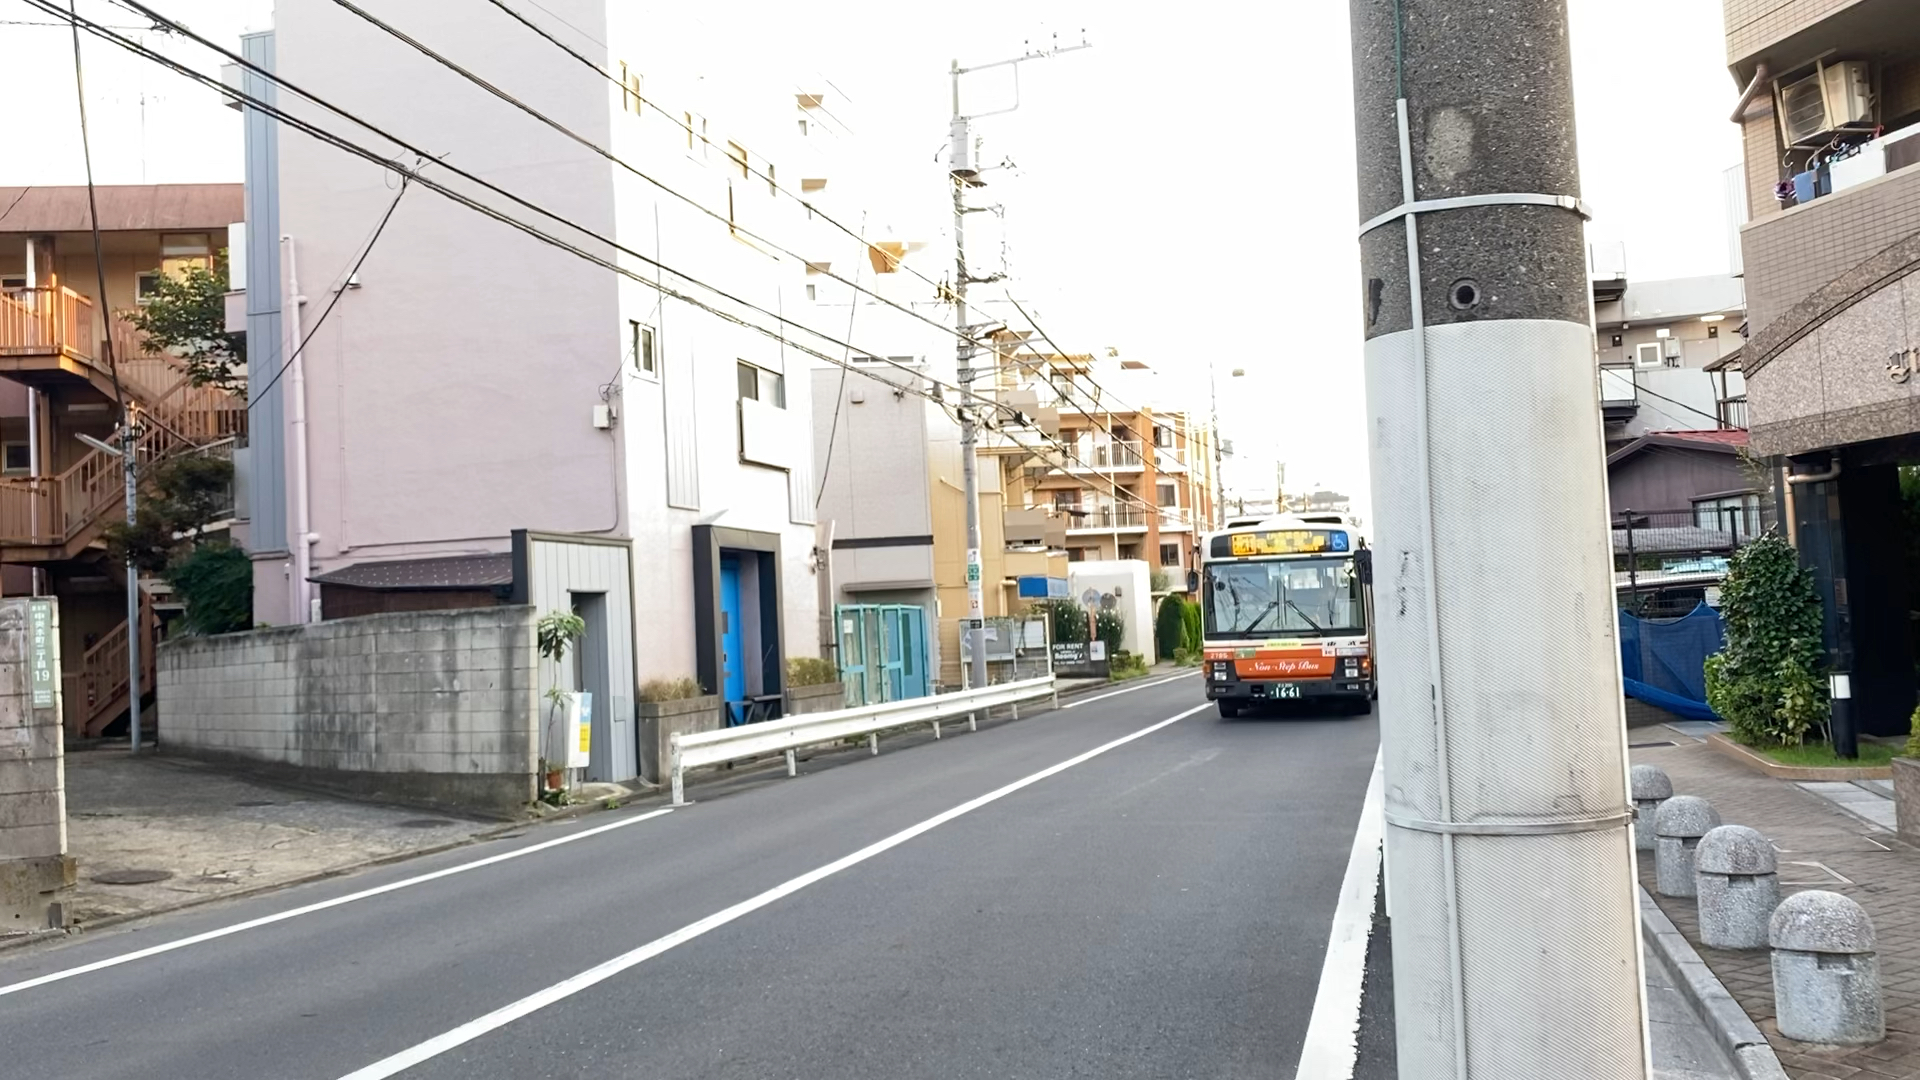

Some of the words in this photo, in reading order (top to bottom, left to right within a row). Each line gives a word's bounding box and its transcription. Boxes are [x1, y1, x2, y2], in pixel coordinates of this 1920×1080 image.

[1052, 643, 1066, 651] FOR
[1066, 641, 1084, 650] RENT
[1297, 660, 1320, 671] Bus
[34, 669, 50, 682] 19
